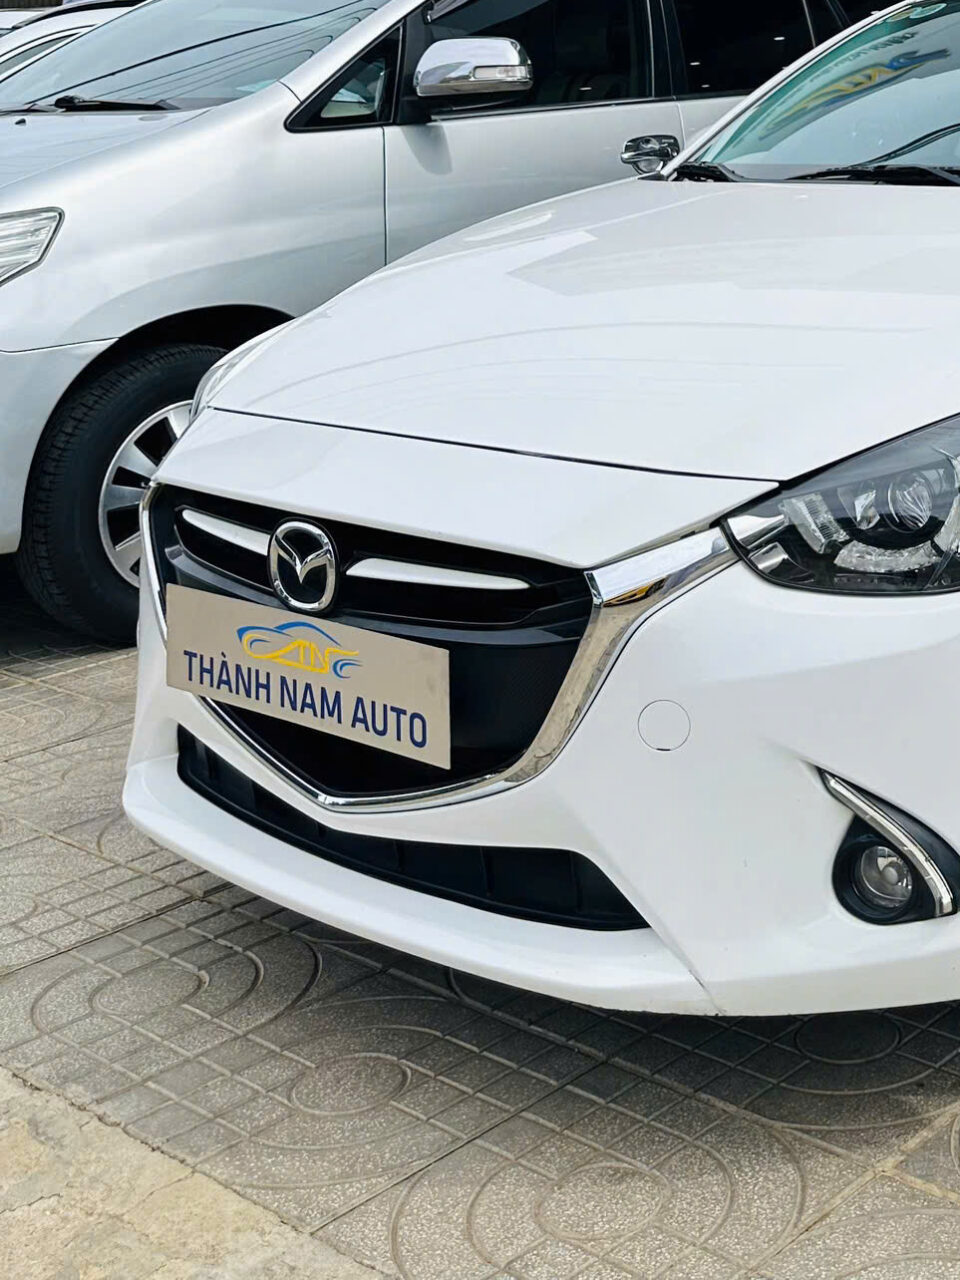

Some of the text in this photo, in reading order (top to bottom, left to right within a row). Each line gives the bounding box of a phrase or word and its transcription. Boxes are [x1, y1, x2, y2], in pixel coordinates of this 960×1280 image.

[183, 649, 428, 749] THÀNH NAM AUTO
